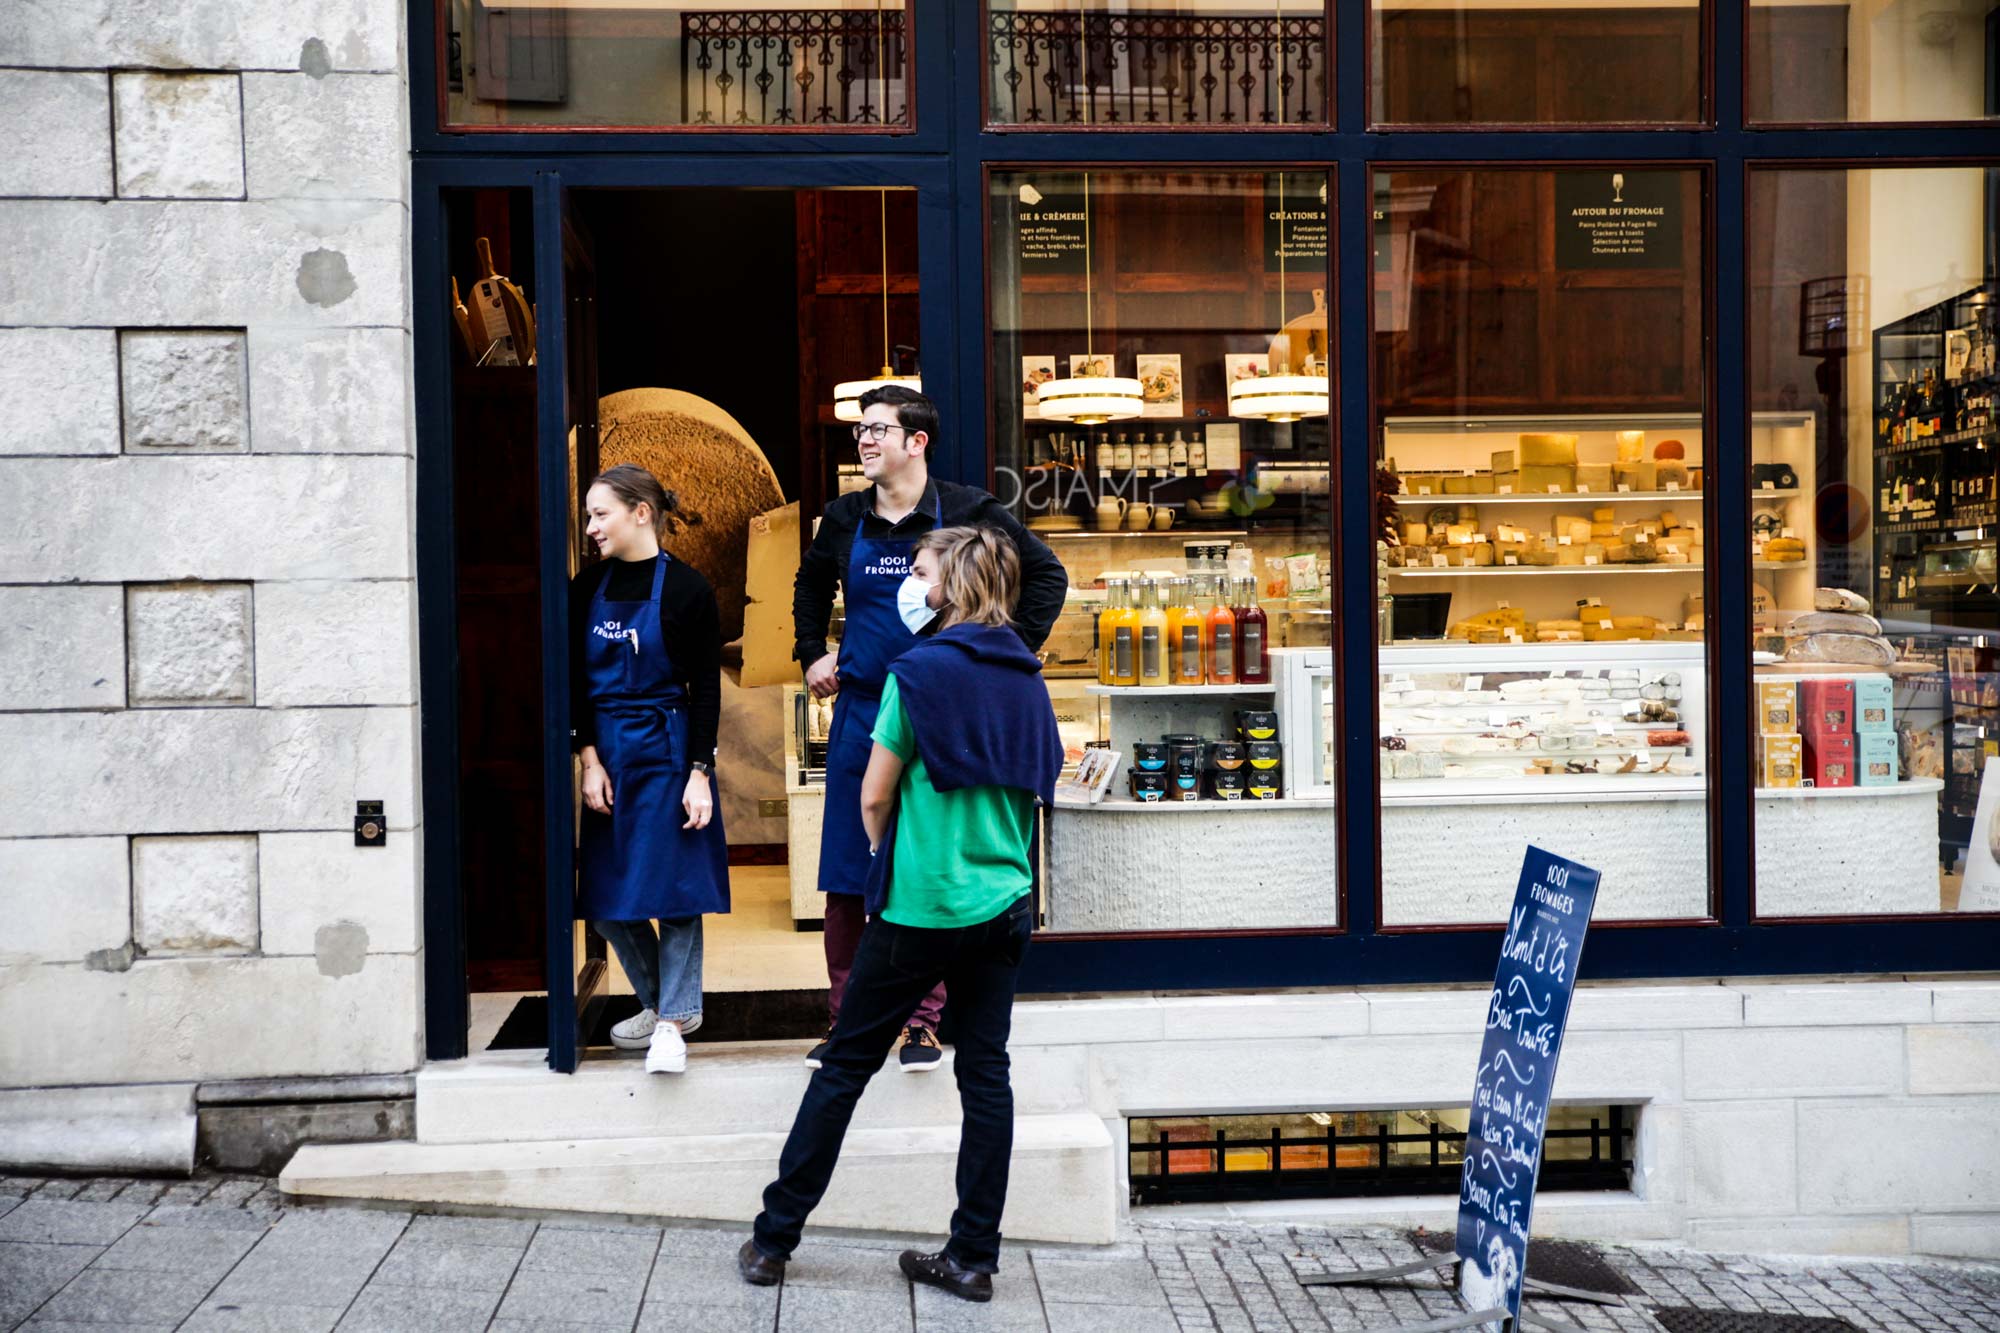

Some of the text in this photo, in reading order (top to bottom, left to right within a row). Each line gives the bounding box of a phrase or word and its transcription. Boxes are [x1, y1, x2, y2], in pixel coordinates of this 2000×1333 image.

[1572, 207, 1665, 216] AUTOUR DU FROMAGE
[1591, 247, 1621, 255] Chutneys
[879, 556, 906, 566] 1001
[865, 565, 913, 575] FROMAGE
[1547, 864, 1569, 889] 1001
[1530, 882, 1575, 915] FROMAGES
[1486, 988, 1555, 1058] Brie Truffé
